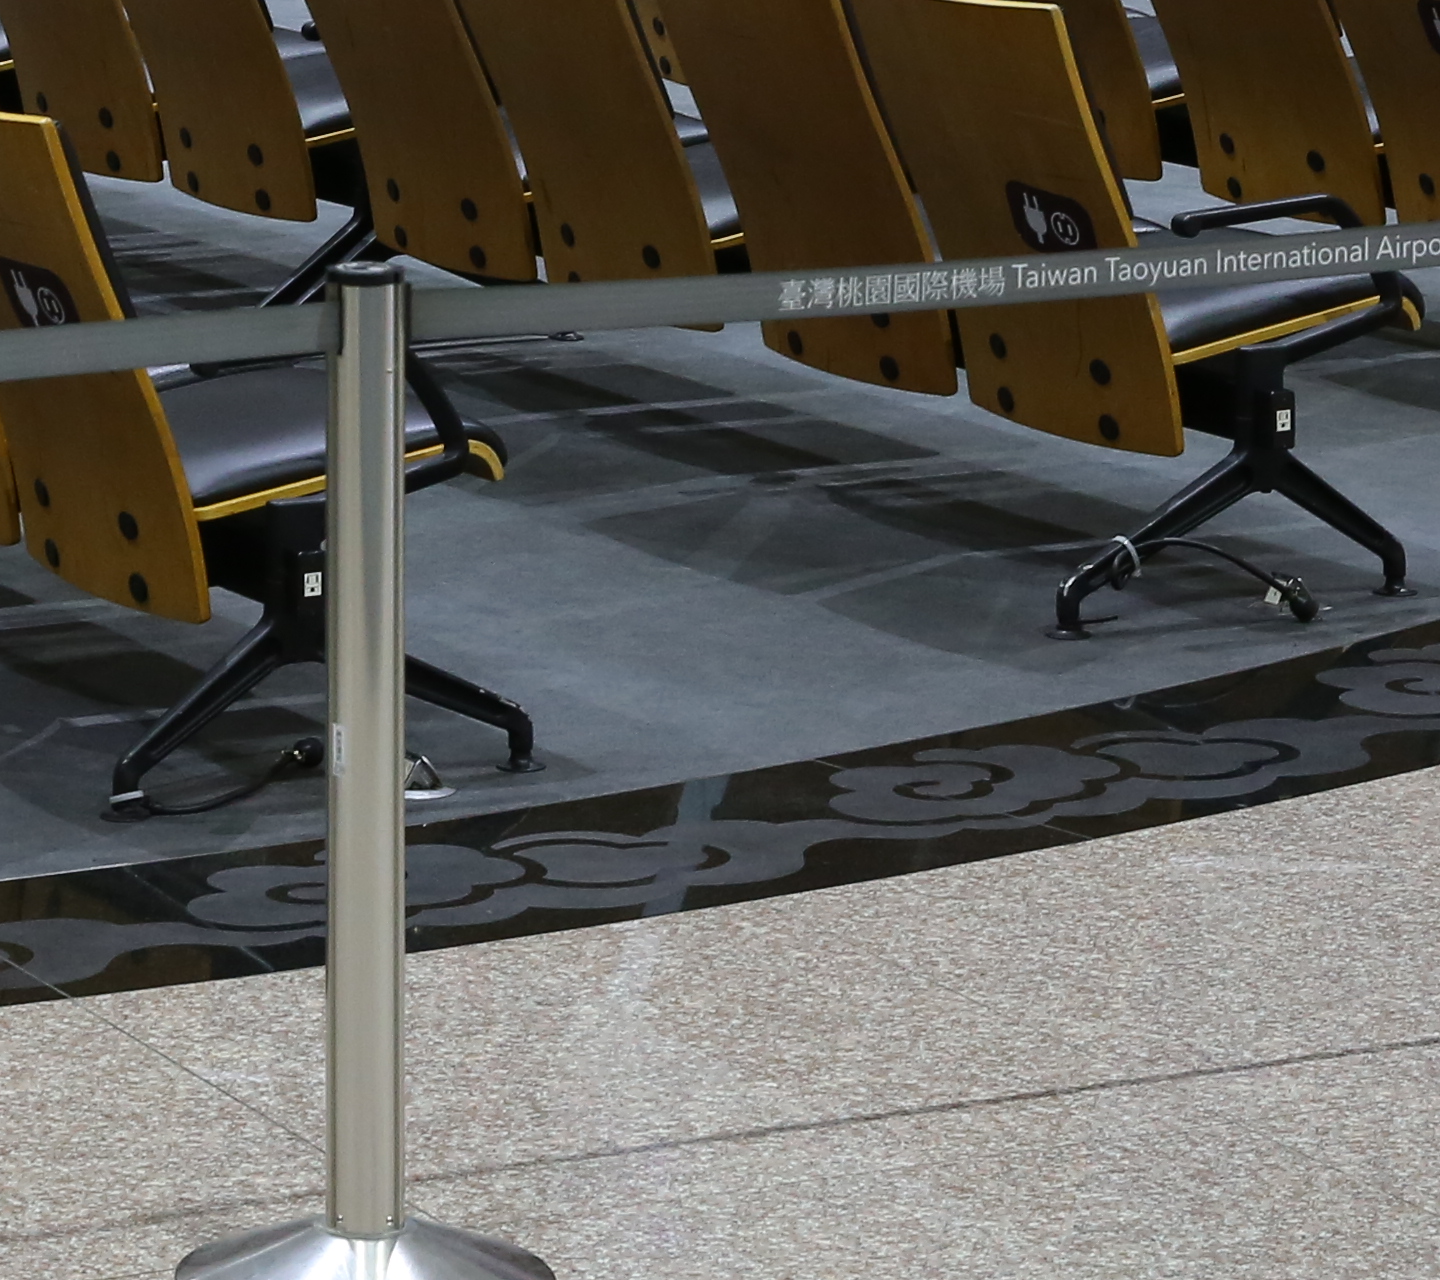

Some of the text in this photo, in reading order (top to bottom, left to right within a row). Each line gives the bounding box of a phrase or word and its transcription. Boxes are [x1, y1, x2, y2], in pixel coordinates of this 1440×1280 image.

[777, 266, 1005, 312] 臺灣桃園國際機場
[1012, 257, 1098, 290] Taiwan
[1104, 251, 1209, 286] Taoyuan
[1216, 237, 1372, 275] International
